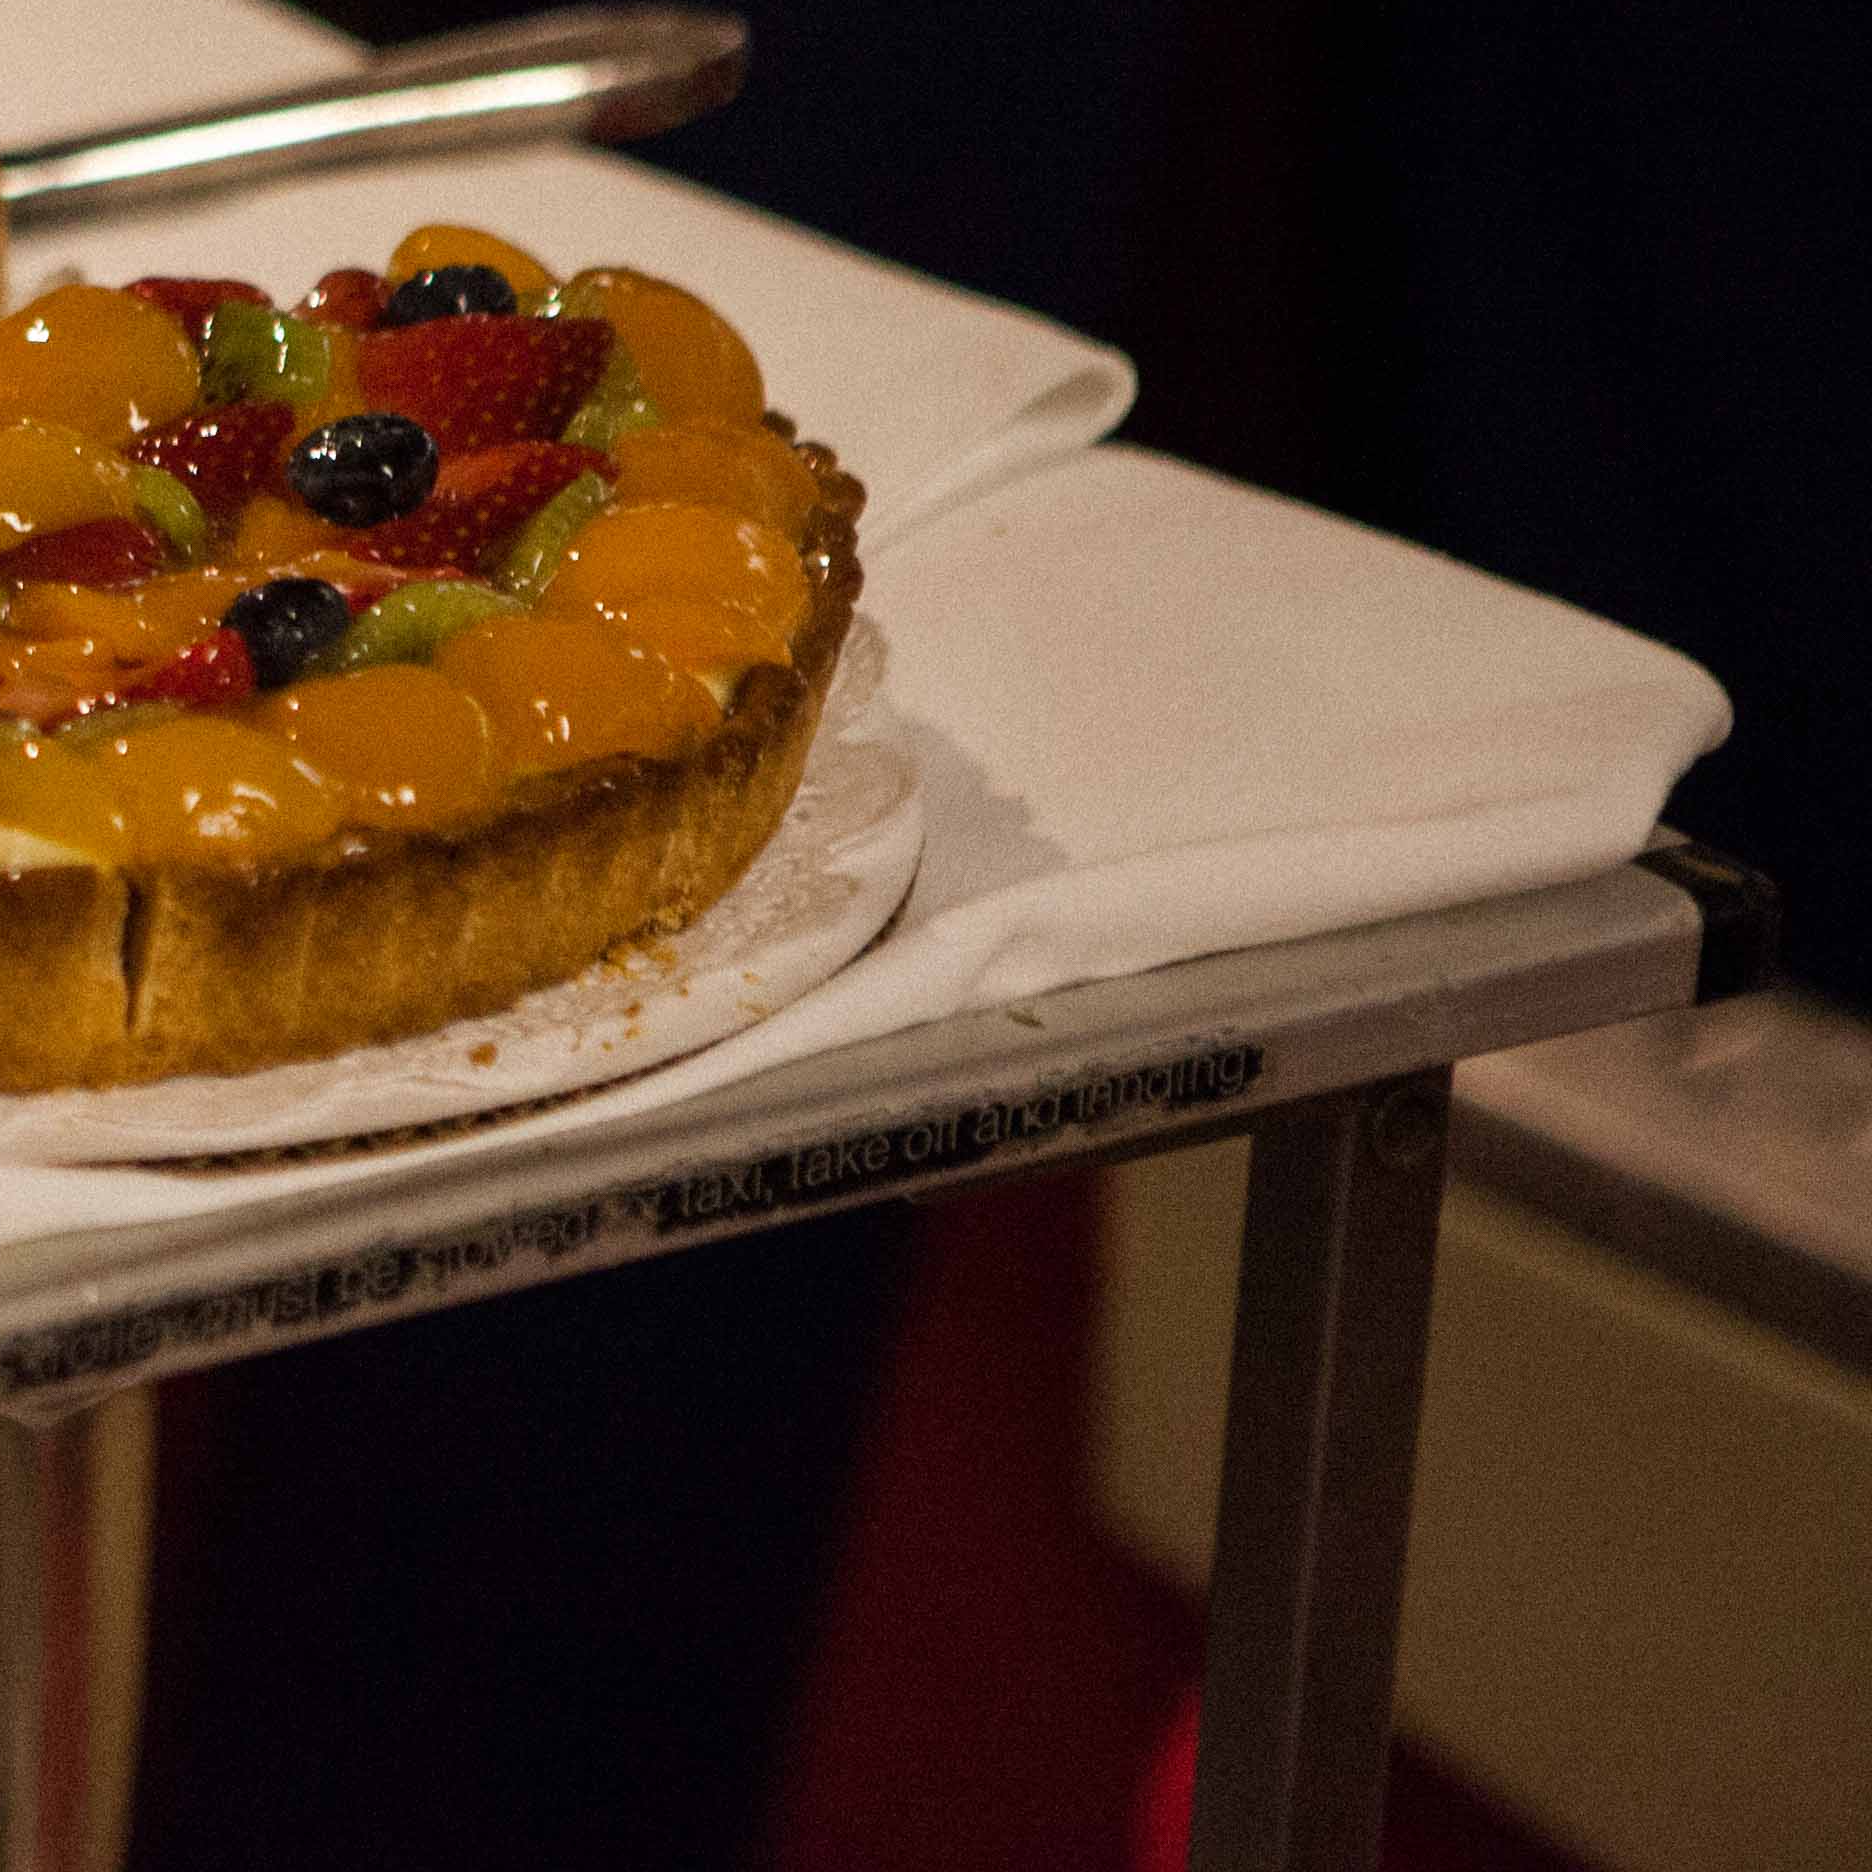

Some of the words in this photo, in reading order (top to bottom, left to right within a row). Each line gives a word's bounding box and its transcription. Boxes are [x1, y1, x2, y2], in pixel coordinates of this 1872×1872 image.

[18, 1300, 186, 1384] trolle
[676, 1158, 774, 1220] taxi,
[787, 1126, 891, 1192] take
[902, 1104, 969, 1163] off
[971, 1083, 1063, 1146] and
[1076, 1044, 1249, 1119] landing
